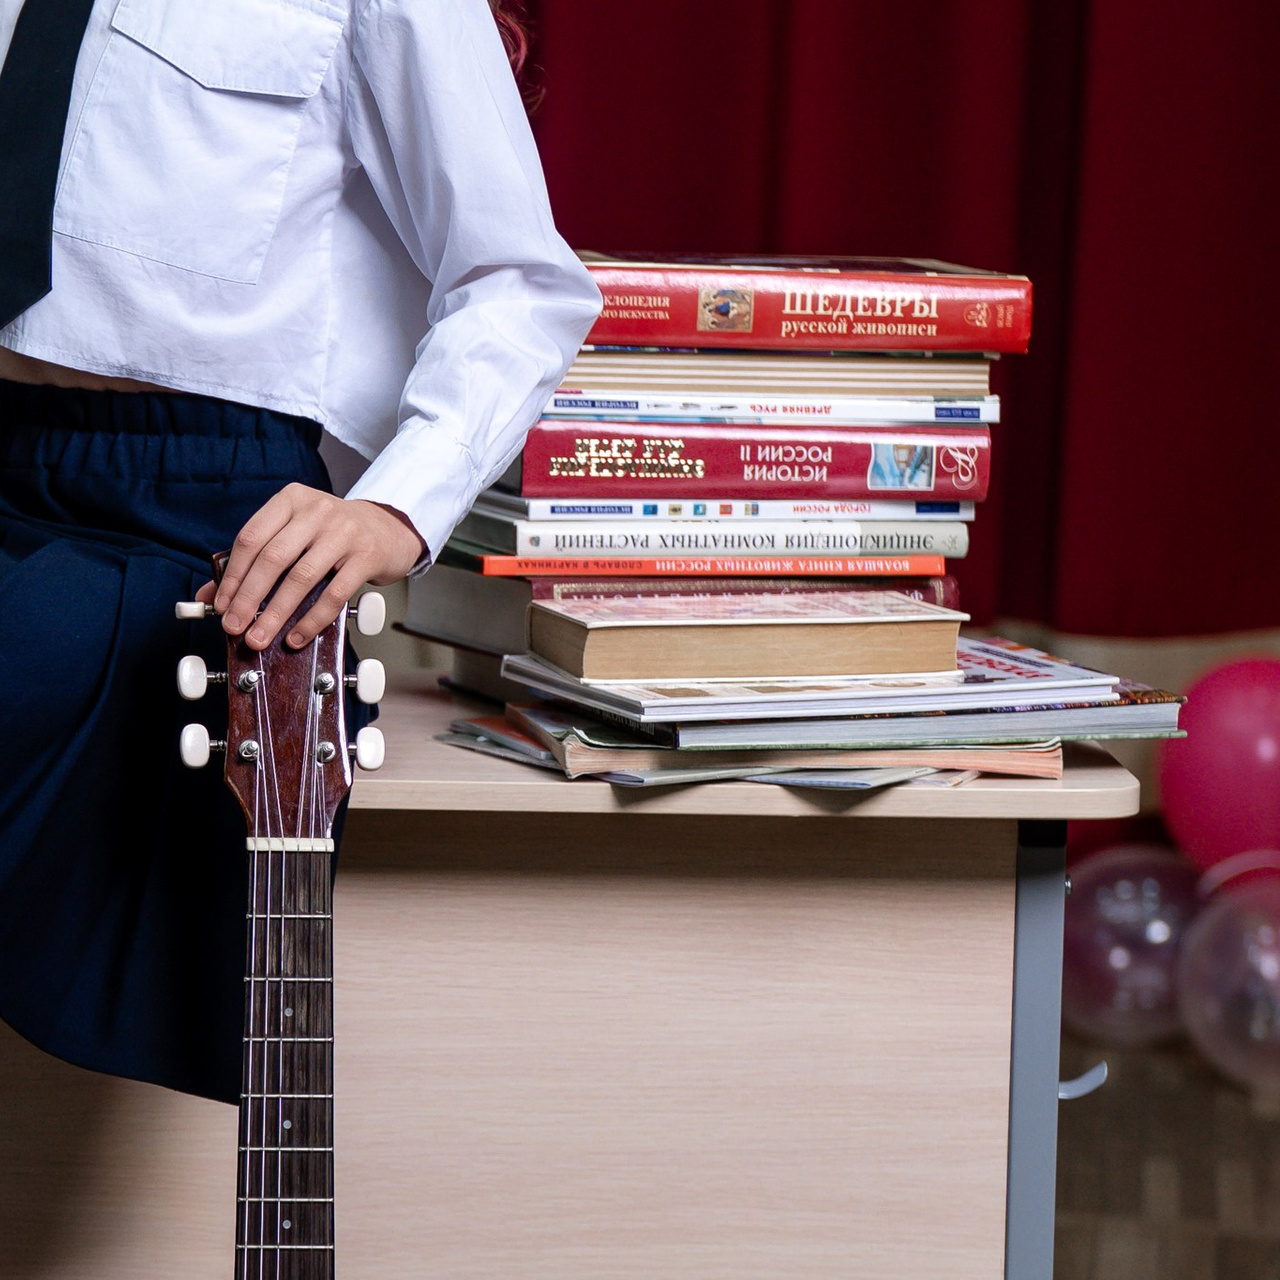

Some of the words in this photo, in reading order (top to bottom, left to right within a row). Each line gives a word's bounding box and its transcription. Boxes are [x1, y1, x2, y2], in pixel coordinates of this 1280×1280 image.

[603, 295, 670, 309] КЛОПЕДИЯ
[782, 289, 939, 320] ШЕДЕВРЫ
[619, 310, 670, 320] ИСКУССТВА
[782, 318, 848, 338] русской
[852, 321, 938, 337] живописи
[556, 399, 593, 408] РОССИИ
[595, 400, 637, 409] ИСТОРИЯ
[750, 404, 777, 414] РУСЬ
[782, 404, 832, 415] ДРЕВНЯЯ
[575, 438, 637, 460] ДЕТЕЙ
[642, 439, 684, 458] ДЛЯ
[740, 444, 751, 462] II
[756, 444, 832, 463] РОССИИ
[550, 457, 705, 479] ЭНЦИКЛОПЕДИЯ
[743, 464, 828, 482] ИСТОРИЯ
[553, 505, 588, 514] РОССИИ
[590, 505, 631, 514] ИСТОРИЯ
[792, 504, 830, 513] РОССИИ
[834, 503, 872, 514] ГОРОДА
[554, 533, 650, 553] РАСТЕНИЙ
[659, 533, 775, 550] КОМНАТНЫХ
[783, 531, 934, 550] ЭНЦИКЛОПЕДИЯ
[516, 561, 578, 570] КАРТИНКАХ
[582, 561, 589, 569] В
[593, 561, 642, 570] СЛОВАРЬ
[655, 560, 711, 572] РОССИИ
[715, 560, 794, 572] ЖИВОТНЫХ
[798, 560, 843, 571] КНИГА
[847, 560, 910, 572] БОЛЬШАЯ
